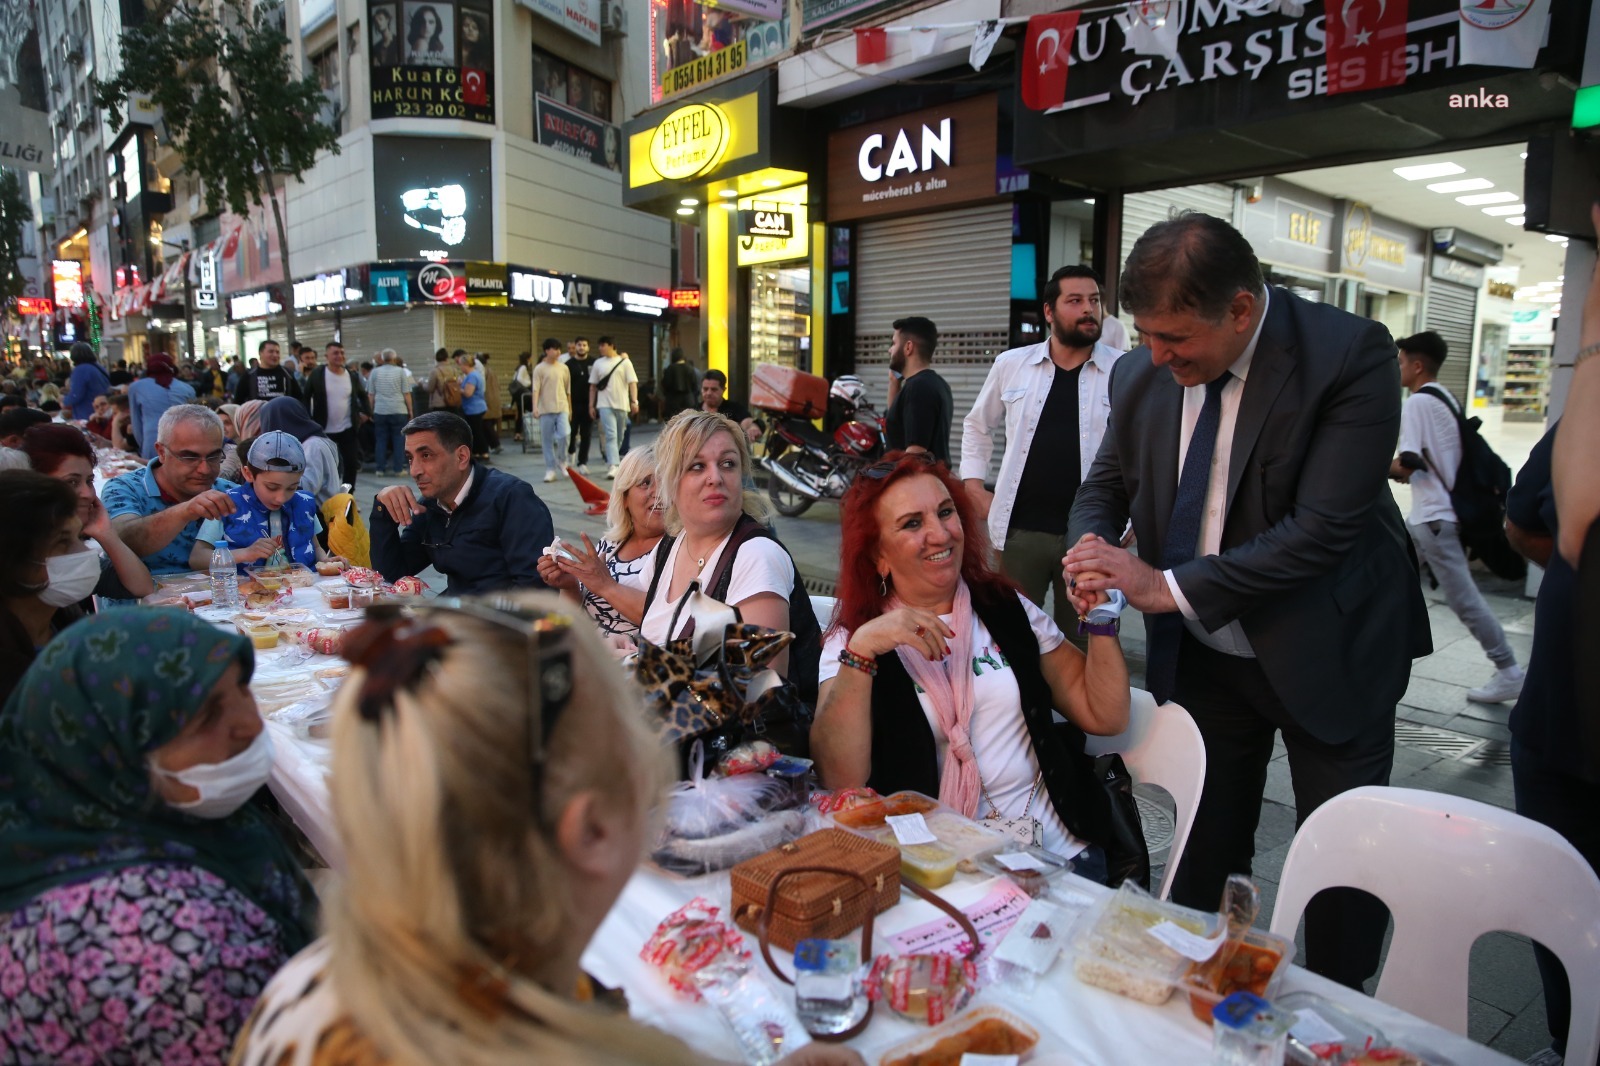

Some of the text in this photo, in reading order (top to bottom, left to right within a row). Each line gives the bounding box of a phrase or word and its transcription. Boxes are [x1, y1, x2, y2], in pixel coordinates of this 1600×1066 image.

[392, 66, 463, 83] Kuafö
[673, 45, 742, 91] 0554 614 31 95
[1287, 57, 1366, 99] SES
[373, 87, 432, 103] HARUN
[395, 102, 466, 117] 323 20 02
[663, 110, 710, 149] EYFEL
[0, 142, 43, 163] LIĞI
[858, 117, 951, 182] CAN
[914, 182, 922, 193] &
[925, 177, 947, 191] altın
[755, 211, 785, 230] CAN
[377, 277, 400, 287] ALTIN
[469, 277, 504, 289] PIRLANTA
[511, 272, 592, 308] MURAT
